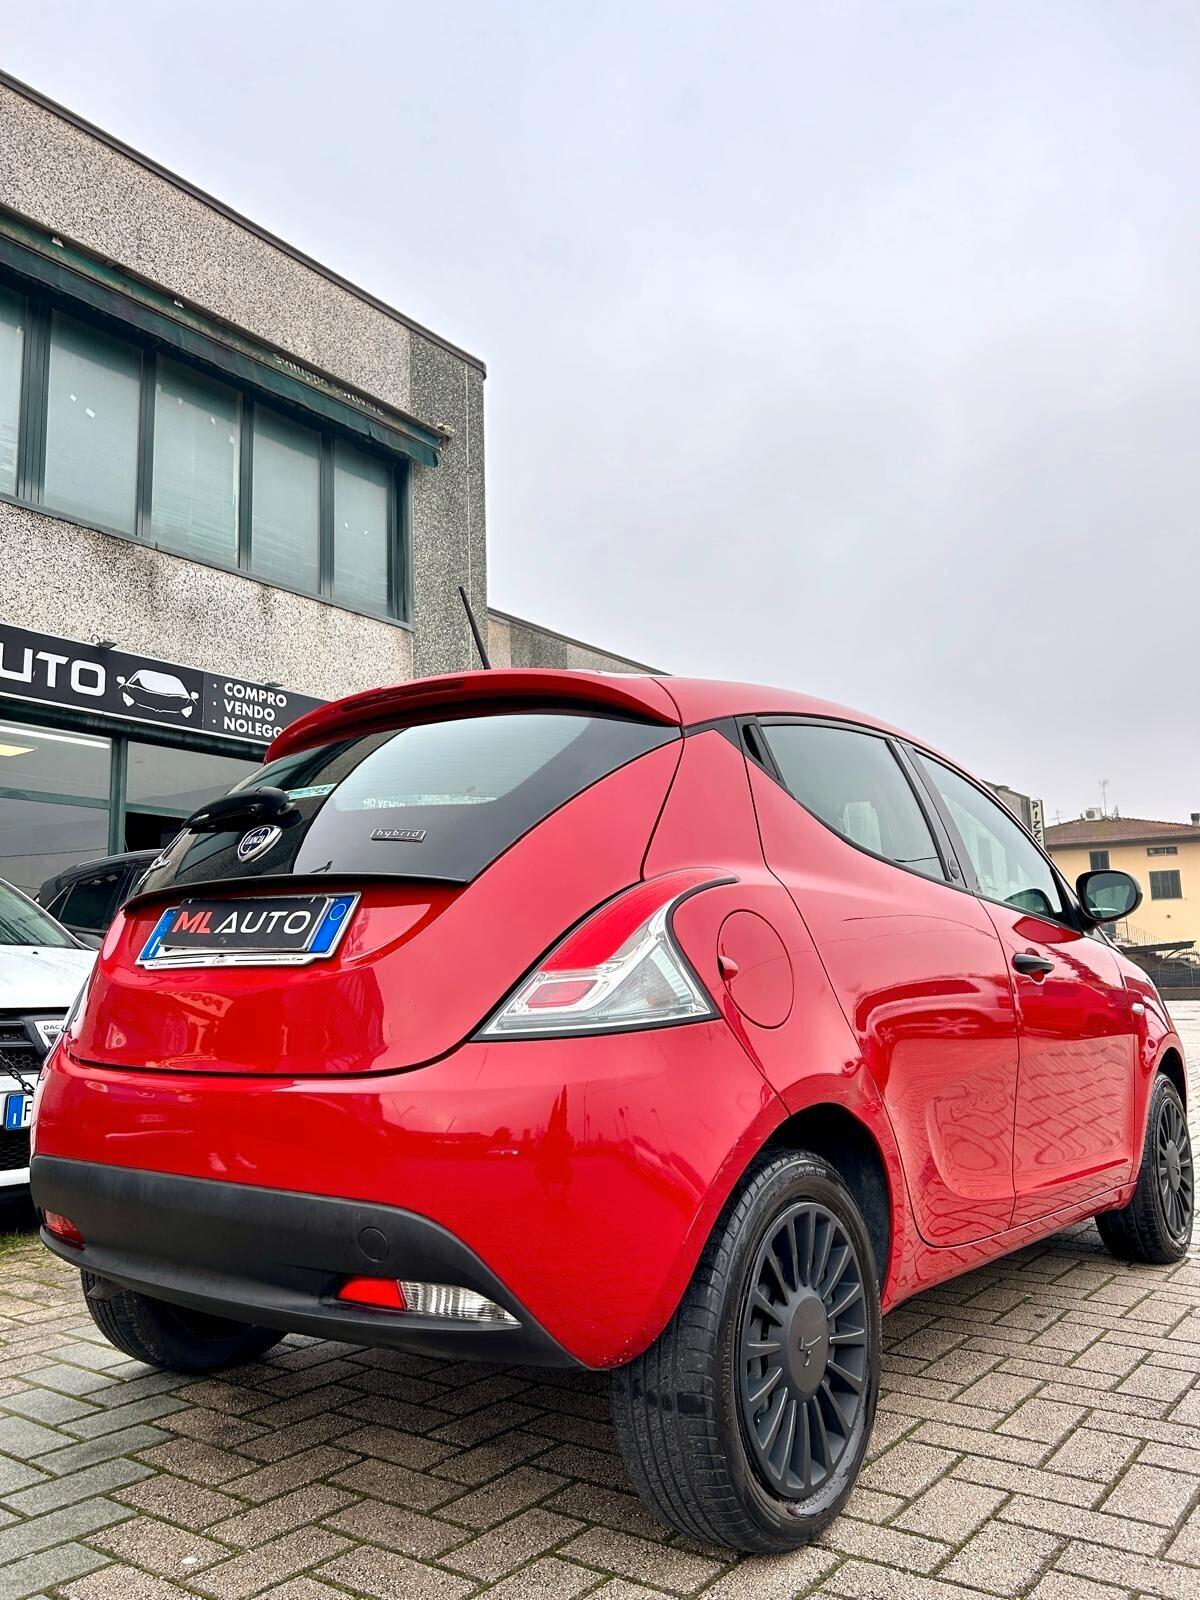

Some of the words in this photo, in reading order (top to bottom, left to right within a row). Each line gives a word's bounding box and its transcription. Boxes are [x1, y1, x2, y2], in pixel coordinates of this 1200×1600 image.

[0, 642, 106, 697] UTO
[224, 682, 287, 708] COMPRO
[223, 698, 276, 722] VENDO
[376, 828, 420, 838] hybrid
[1031, 800, 1042, 844] PIZZ
[171, 911, 213, 934] ML
[214, 911, 312, 935] AUTO
